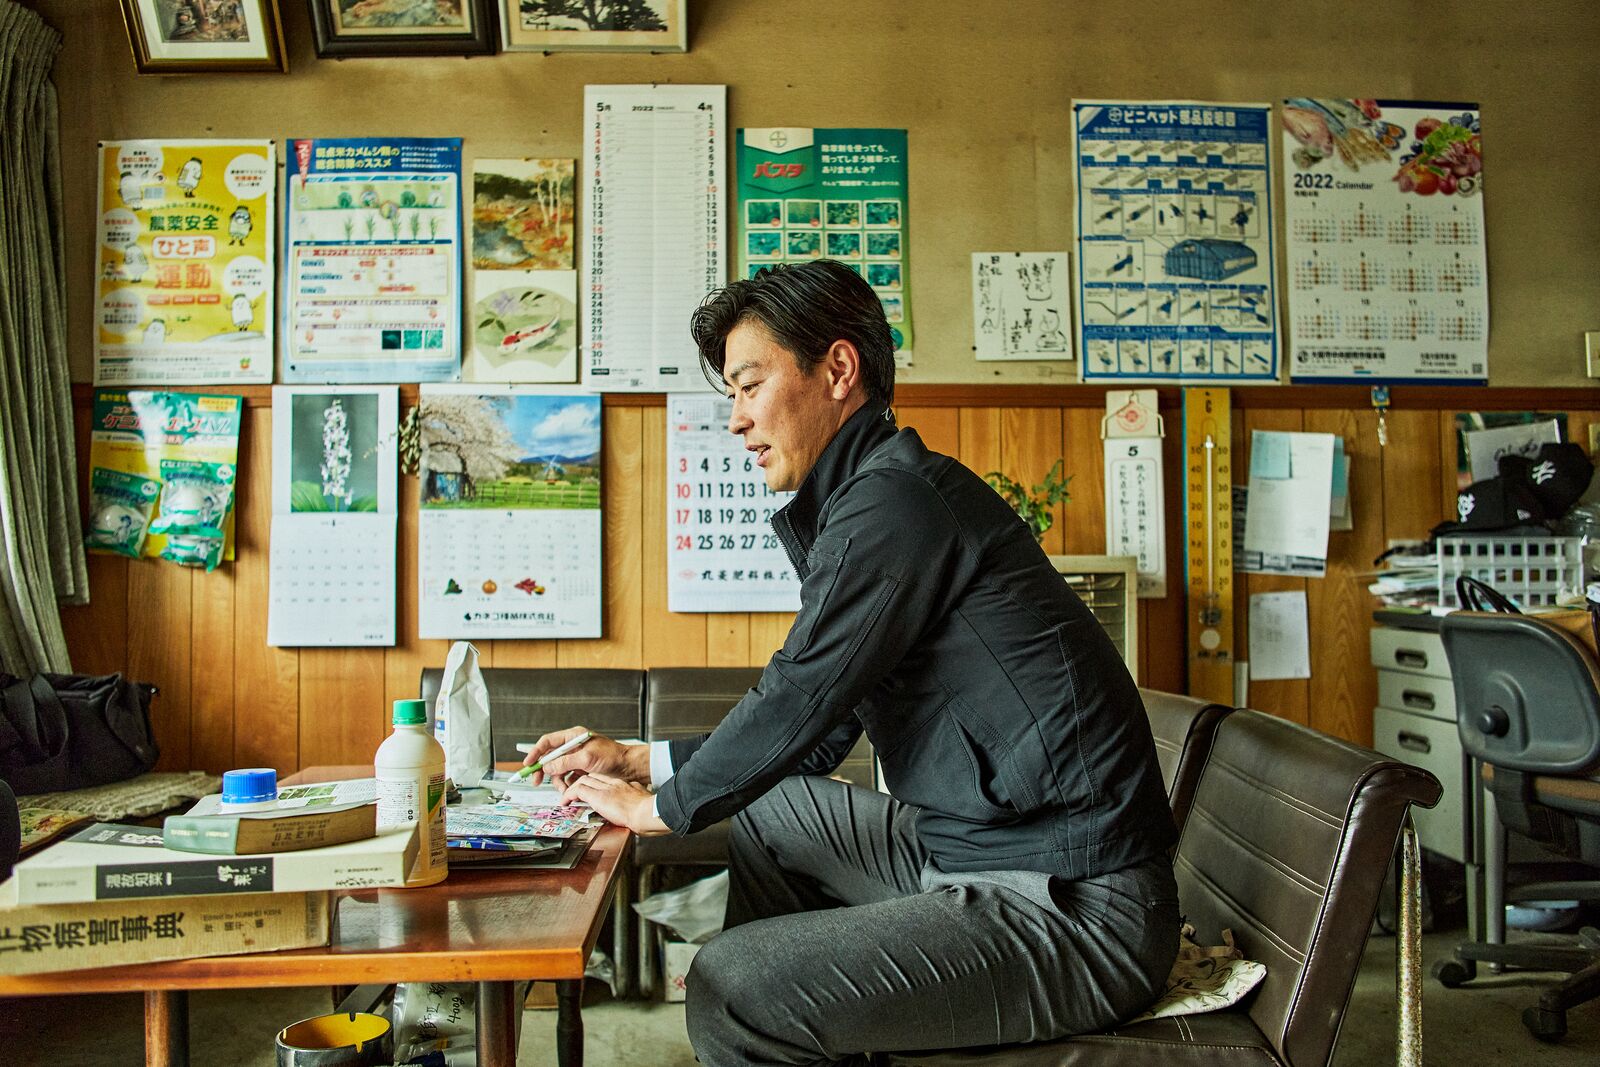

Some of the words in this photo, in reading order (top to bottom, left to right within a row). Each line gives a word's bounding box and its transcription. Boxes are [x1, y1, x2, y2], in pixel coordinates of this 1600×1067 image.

[597, 102, 611, 112] 5月
[698, 102, 712, 112] 4月
[754, 162, 805, 178] バスタ
[1294, 173, 1334, 189] 2022
[1336, 182, 1374, 190] Calendar
[150, 214, 220, 231] 農薬安全
[158, 239, 210, 256] ひと声
[154, 264, 211, 289] 運動
[1128, 446, 1138, 456] 5
[680, 458, 687, 472] 3
[700, 458, 708, 472] 4
[722, 458, 730, 472] 5
[744, 458, 751, 472] 6
[676, 484, 690, 498] 10
[699, 484, 711, 498] 11
[720, 484, 734, 498] 12
[741, 483, 755, 497] 13
[676, 510, 690, 524] 17
[698, 510, 712, 524] 18
[720, 510, 733, 523] 19
[740, 509, 756, 523] 20
[763, 509, 777, 523] 2
[676, 536, 691, 550] 24
[698, 536, 713, 550] 25
[720, 536, 734, 550] 26
[741, 535, 756, 549] 27
[763, 535, 778, 548] 28
[1221, 540, 1227, 548] 0
[1192, 559, 1202, 567] 10
[1219, 559, 1229, 567] 10
[702, 570, 800, 580] 丸菱肥料株式
[1192, 577, 1202, 585] 20
[1219, 577, 1229, 585] 20
[474, 612, 554, 621] カネコ種苗株式会社
[447, 997, 465, 1024] 400g
